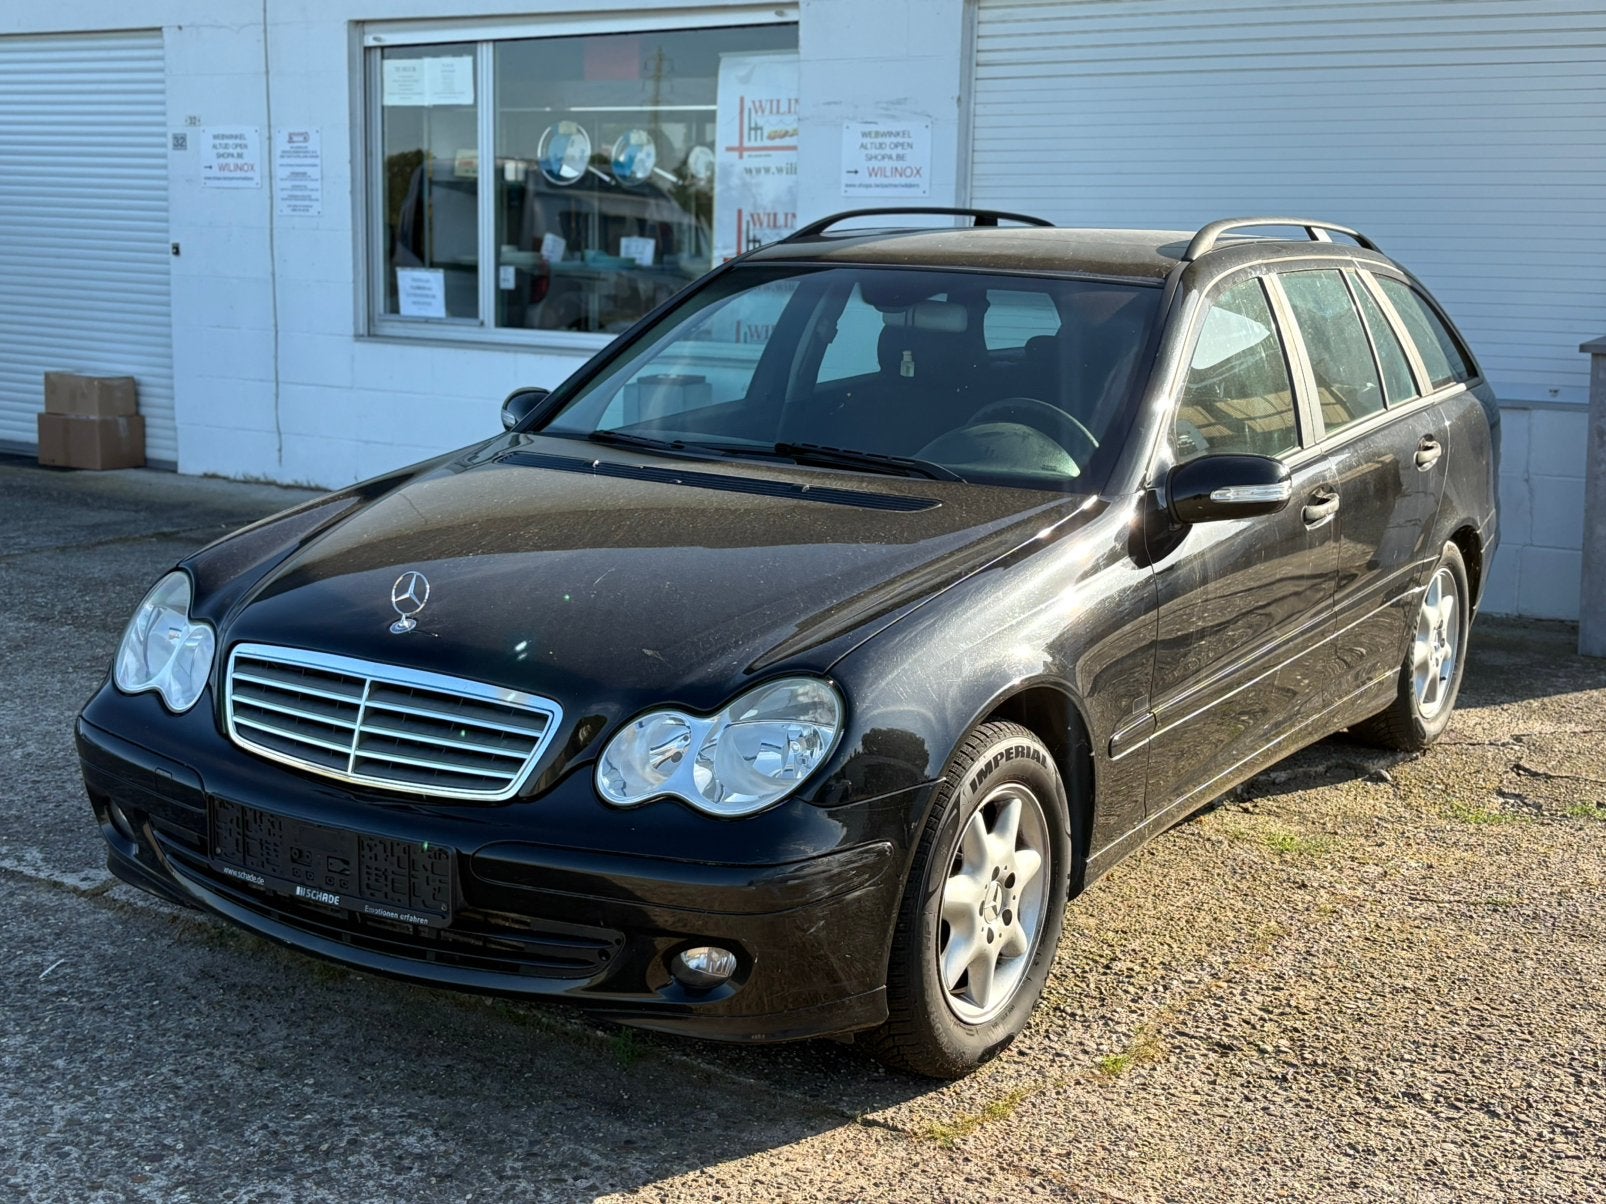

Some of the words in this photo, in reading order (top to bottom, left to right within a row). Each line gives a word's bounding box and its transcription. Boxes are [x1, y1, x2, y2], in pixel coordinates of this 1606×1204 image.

[211, 133, 247, 141] WEBWINKEL
[860, 130, 912, 139] WEBWINKEL
[172, 136, 186, 149] 32
[889, 141, 914, 151] OPEN
[864, 152, 907, 161] SHOPA.BE
[217, 163, 256, 173] WILINOX
[867, 166, 923, 178] WILINOX
[969, 744, 1048, 795] IMPERIAL
[223, 866, 265, 886] www.schade.de
[303, 888, 340, 906] SCHADE
[364, 904, 399, 919] Emotionen
[399, 914, 429, 925] erfahren
